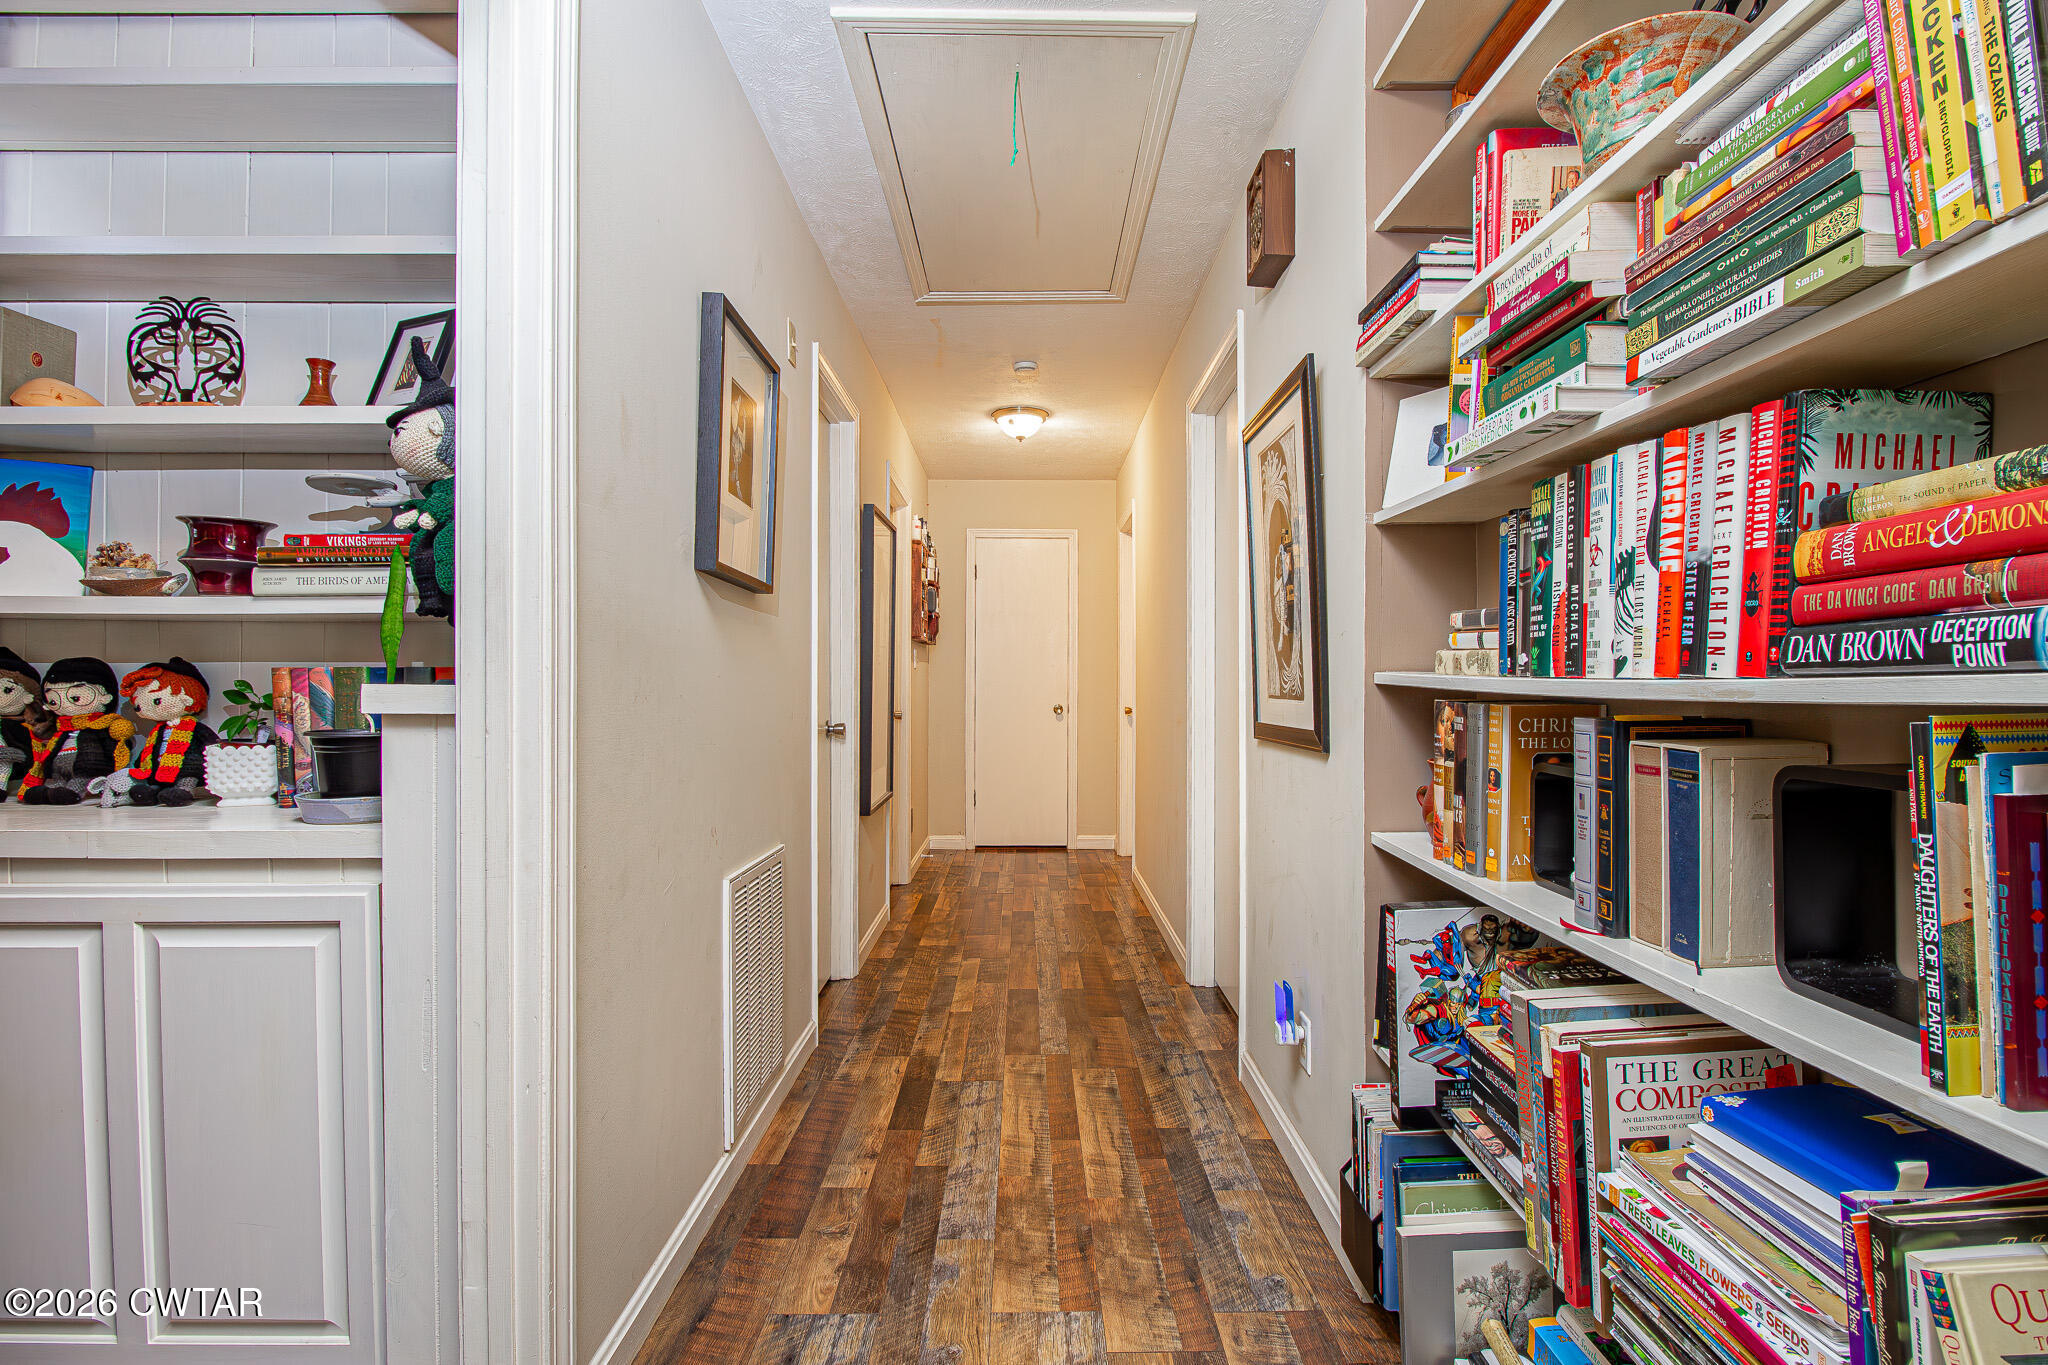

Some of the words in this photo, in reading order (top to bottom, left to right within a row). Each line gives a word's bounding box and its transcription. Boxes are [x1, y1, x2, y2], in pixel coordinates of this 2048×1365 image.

[1867, 17, 1884, 57] KEEPING
[1892, 17, 1906, 74] Chickens
[1971, 40, 1982, 62] Peter
[1983, 16, 1997, 53] THE
[1873, 53, 1888, 87] HACKS
[1989, 51, 2007, 123] OZARKS
[2012, 37, 2041, 124] MEDICINE
[1901, 78, 1913, 113] BEYOND
[1708, 151, 1740, 178] HERBAL
[1740, 98, 1807, 153] DISPENSATORY
[1726, 136, 1745, 154] THE
[1744, 105, 1786, 140] MODERN
[1904, 112, 1915, 130] THE
[2023, 122, 2041, 156] GUIDE
[1907, 129, 1919, 160] BASICS
[1938, 100, 1957, 180] ENCYCLOPEDIA
[1706, 193, 1738, 222] FORGOTTEN
[1736, 182, 1756, 206] HOME
[1753, 159, 1791, 195] APOTHECARY
[1828, 188, 1844, 205] Davis
[1496, 250, 1544, 296] Encyclopedia
[1665, 297, 1693, 322] BARBARA
[1715, 268, 1748, 296] NATURAL
[1746, 246, 1784, 279] REMEDIES
[1795, 267, 1826, 291] Smith
[1683, 294, 1717, 321] COMPLETE
[1715, 272, 1759, 304] COLLECTION
[1651, 330, 1687, 364] Vegetable
[1687, 310, 1733, 348] Gardener's
[1733, 288, 1777, 324] BIBLE
[1501, 383, 1523, 403] ORGANIC
[1523, 364, 1555, 391] GARDENING
[1462, 419, 1502, 446] ENCYCLOPEDIA
[1480, 420, 1514, 445] MEDICINE
[1756, 409, 1775, 475] MICHAEL
[1778, 407, 1798, 489] MICHAEL
[1692, 431, 1706, 488] MICHAEL
[1834, 432, 1956, 471] MICHAEL
[1637, 449, 1650, 501] MICHAEL
[1714, 426, 1737, 529] MICHAEL
[1913, 486, 1946, 500] SOUND
[1958, 476, 1988, 491] PAPER
[1555, 483, 1565, 514] MICHAEL
[1659, 447, 1688, 573] AIRFRAME
[1752, 478, 1772, 550] CRICHTON
[1856, 501, 1894, 515] CAMERON
[1863, 494, 1885, 506] JULIA
[1508, 514, 1517, 547] MICHAEL
[1554, 514, 1564, 549] CRICHTON
[1567, 480, 1575, 570] DISCLOSURE
[1634, 507, 1648, 566] CRICHTON
[1687, 492, 1703, 553] CRICHTON
[1862, 518, 1938, 553] ANGELS
[1930, 504, 1975, 549] &
[1961, 498, 2048, 538] DEMONS
[296, 547, 347, 557] AMERICAN
[326, 536, 367, 547] VIKINGS
[1830, 532, 1845, 561] DAN
[1842, 522, 1862, 567] BROWN
[296, 576, 316, 586] THE
[318, 576, 349, 586] BIRDS
[350, 576, 363, 585] OF
[1507, 548, 1517, 588] CRICHTON
[1635, 574, 1645, 592] THE
[1684, 561, 1698, 599] STATE
[1928, 578, 1957, 601] DAN
[1963, 569, 2019, 596] BROWN
[1552, 581, 1562, 620] RISING
[1634, 597, 1645, 620] LOST
[1684, 601, 1694, 611] OF
[1707, 545, 1732, 656] CRICHTON
[1768, 544, 1792, 637] CRICHTON
[1804, 591, 1823, 612] THE
[1827, 589, 1842, 610] DA
[1844, 586, 1879, 608] VINCI
[1883, 580, 1917, 604] CODE
[1570, 585, 1579, 650] MICHAEL
[1662, 586, 1673, 639] MICHAEL
[1681, 615, 1695, 646] FEAR
[1930, 612, 2036, 644] DECEPTION
[1551, 625, 1560, 647] SUN
[1633, 625, 1644, 658] WORLD
[1786, 632, 1836, 664] DAN
[1838, 626, 1928, 663] BROWN
[1951, 642, 2008, 668] POINT
[1518, 738, 1548, 749] THE
[1918, 833, 1939, 942] DAUGHTERS
[1386, 913, 1396, 970] MARVEL
[1925, 942, 1938, 967] OF
[1998, 883, 2013, 1032] DICTIONARY
[1926, 967, 1941, 1000] THE
[1928, 1002, 1944, 1056] EARTH
[1515, 1040, 1529, 1070] ART
[1615, 1060, 1678, 1085] THE
[1692, 1053, 1791, 1081] GREAT
[1516, 1069, 1533, 1129] HISTORY
[1553, 1057, 1566, 1138] Leonardo
[1584, 1095, 1592, 1121] THE
[1534, 1092, 1548, 1167] HISTORY
[1629, 1124, 1667, 1132] INFLUENCES
[1633, 1115, 1675, 1124] ILLUSTRATED
[1676, 1113, 1696, 1121] GUIDE
[1548, 1111, 1560, 1186] PHOTOGRAPHY
[1558, 1139, 1568, 1156] DA
[1586, 1125, 1596, 1175] GREAT
[1458, 1173, 1482, 1181] THE
[1558, 1155, 1569, 1184] VINCI
[1588, 1176, 1598, 1258] COMPOSERS
[1843, 1221, 1857, 1256] Quilt
[1622, 1196, 1655, 1236] TREES,
[1655, 1223, 1698, 1270] LEAVES,
[1699, 1258, 1754, 1311] FLOWERS
[1755, 1300, 1765, 1321] &
[1766, 1310, 1810, 1356] SEEDS
[1845, 1255, 1858, 1287] with
[1847, 1284, 1859, 1306] the
[1847, 1305, 1862, 1337] Best
